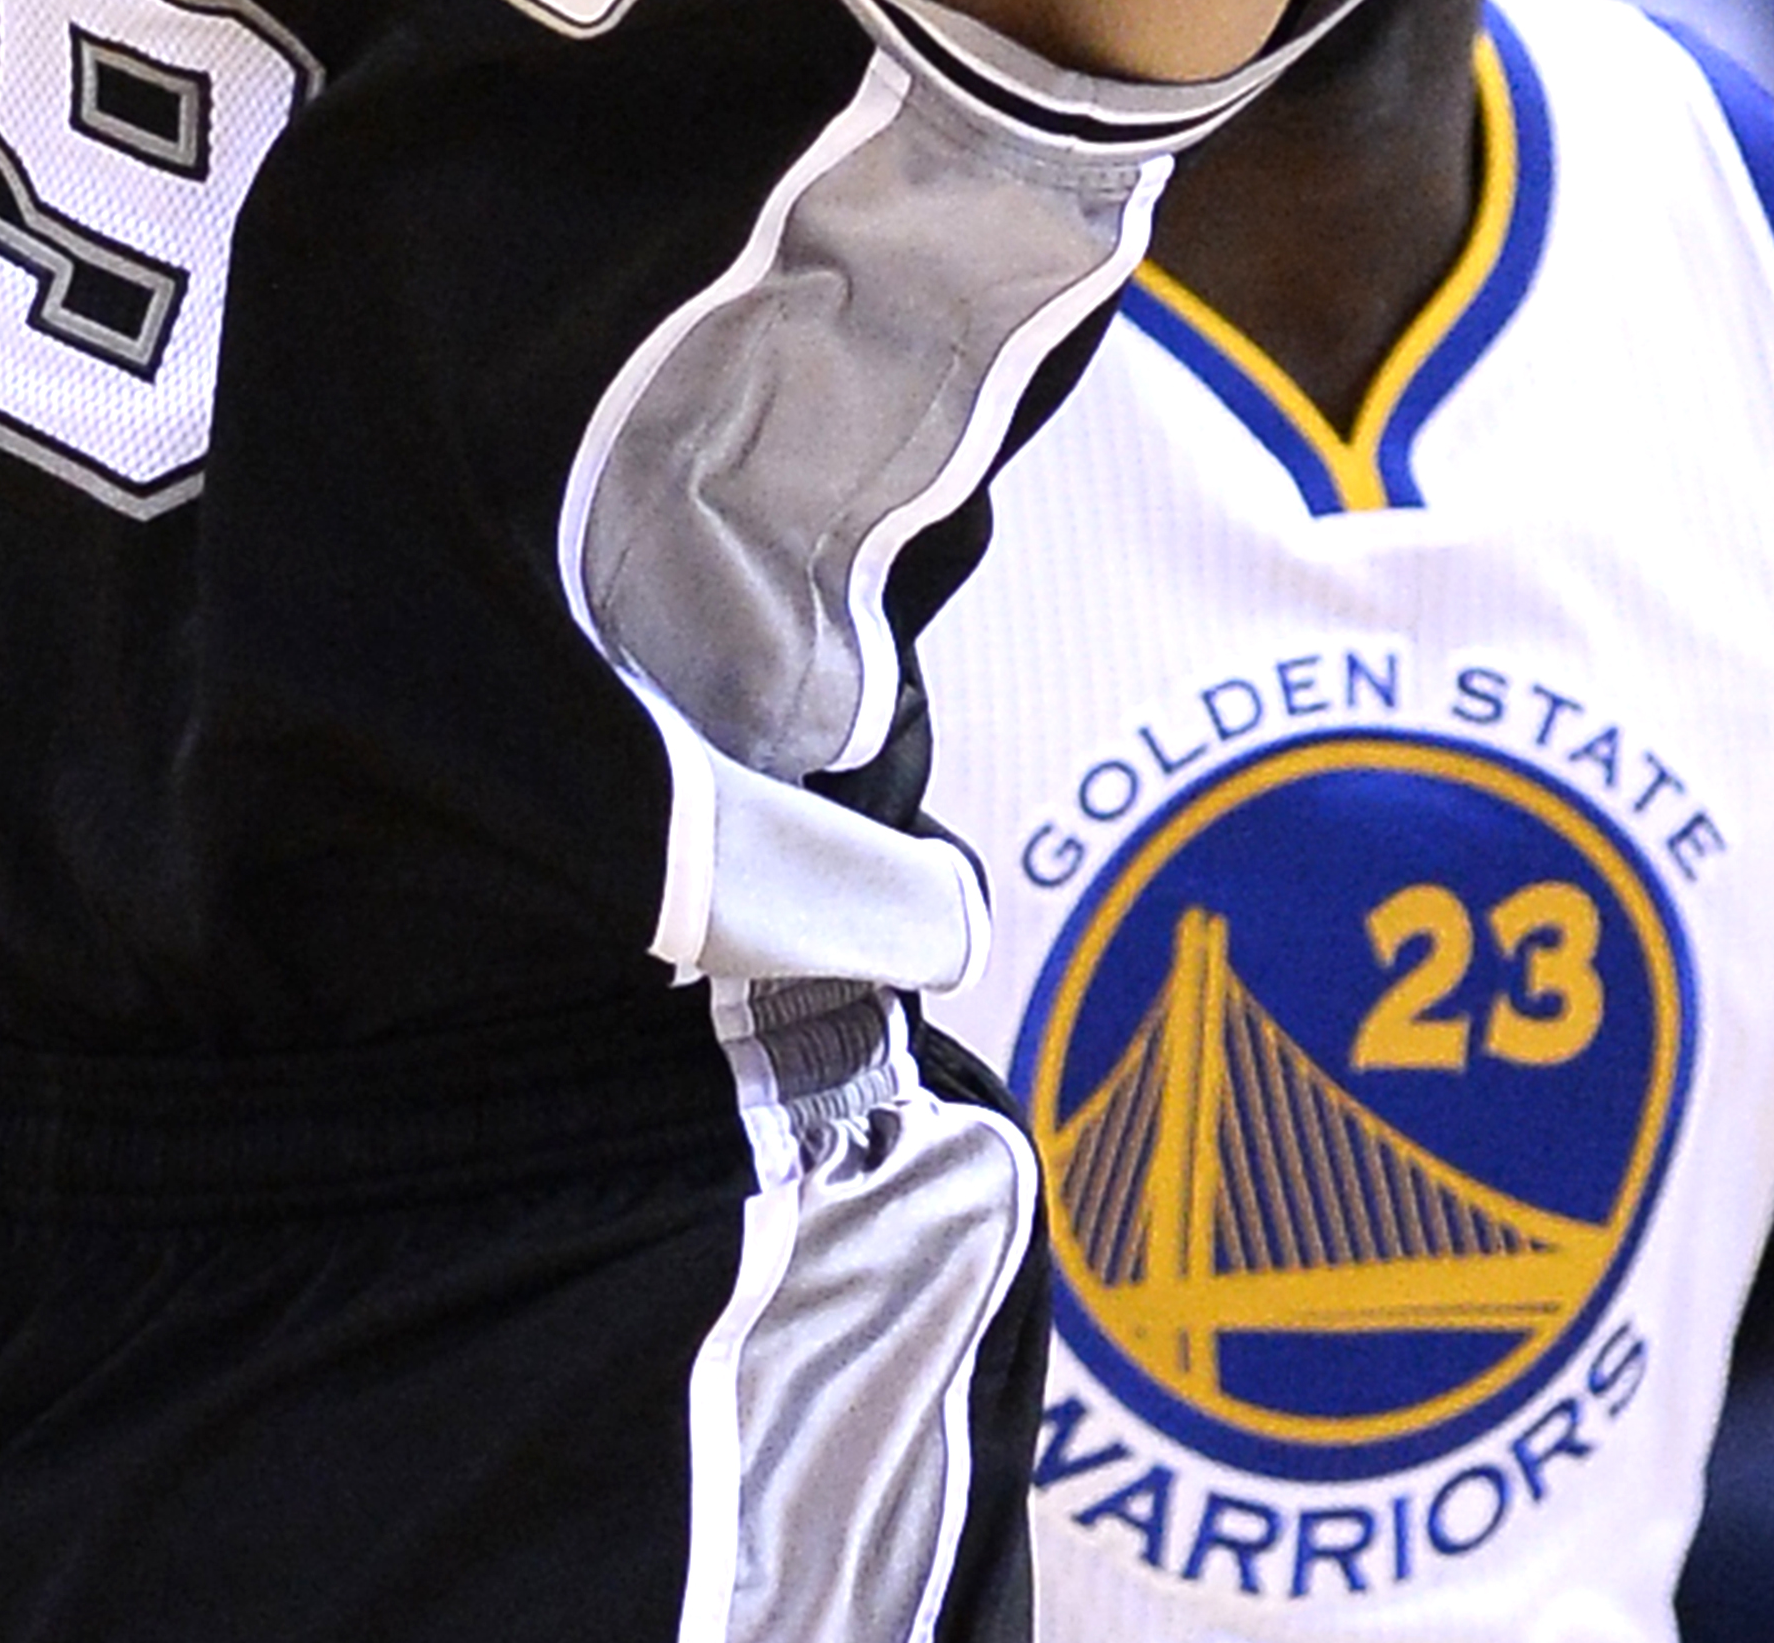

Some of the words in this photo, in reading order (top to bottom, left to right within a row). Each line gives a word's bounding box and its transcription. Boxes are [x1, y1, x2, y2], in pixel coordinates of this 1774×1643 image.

[1019, 649, 1401, 891] GOLDEN
[1451, 666, 1727, 883] STATE
[1349, 880, 1606, 1074] 23
